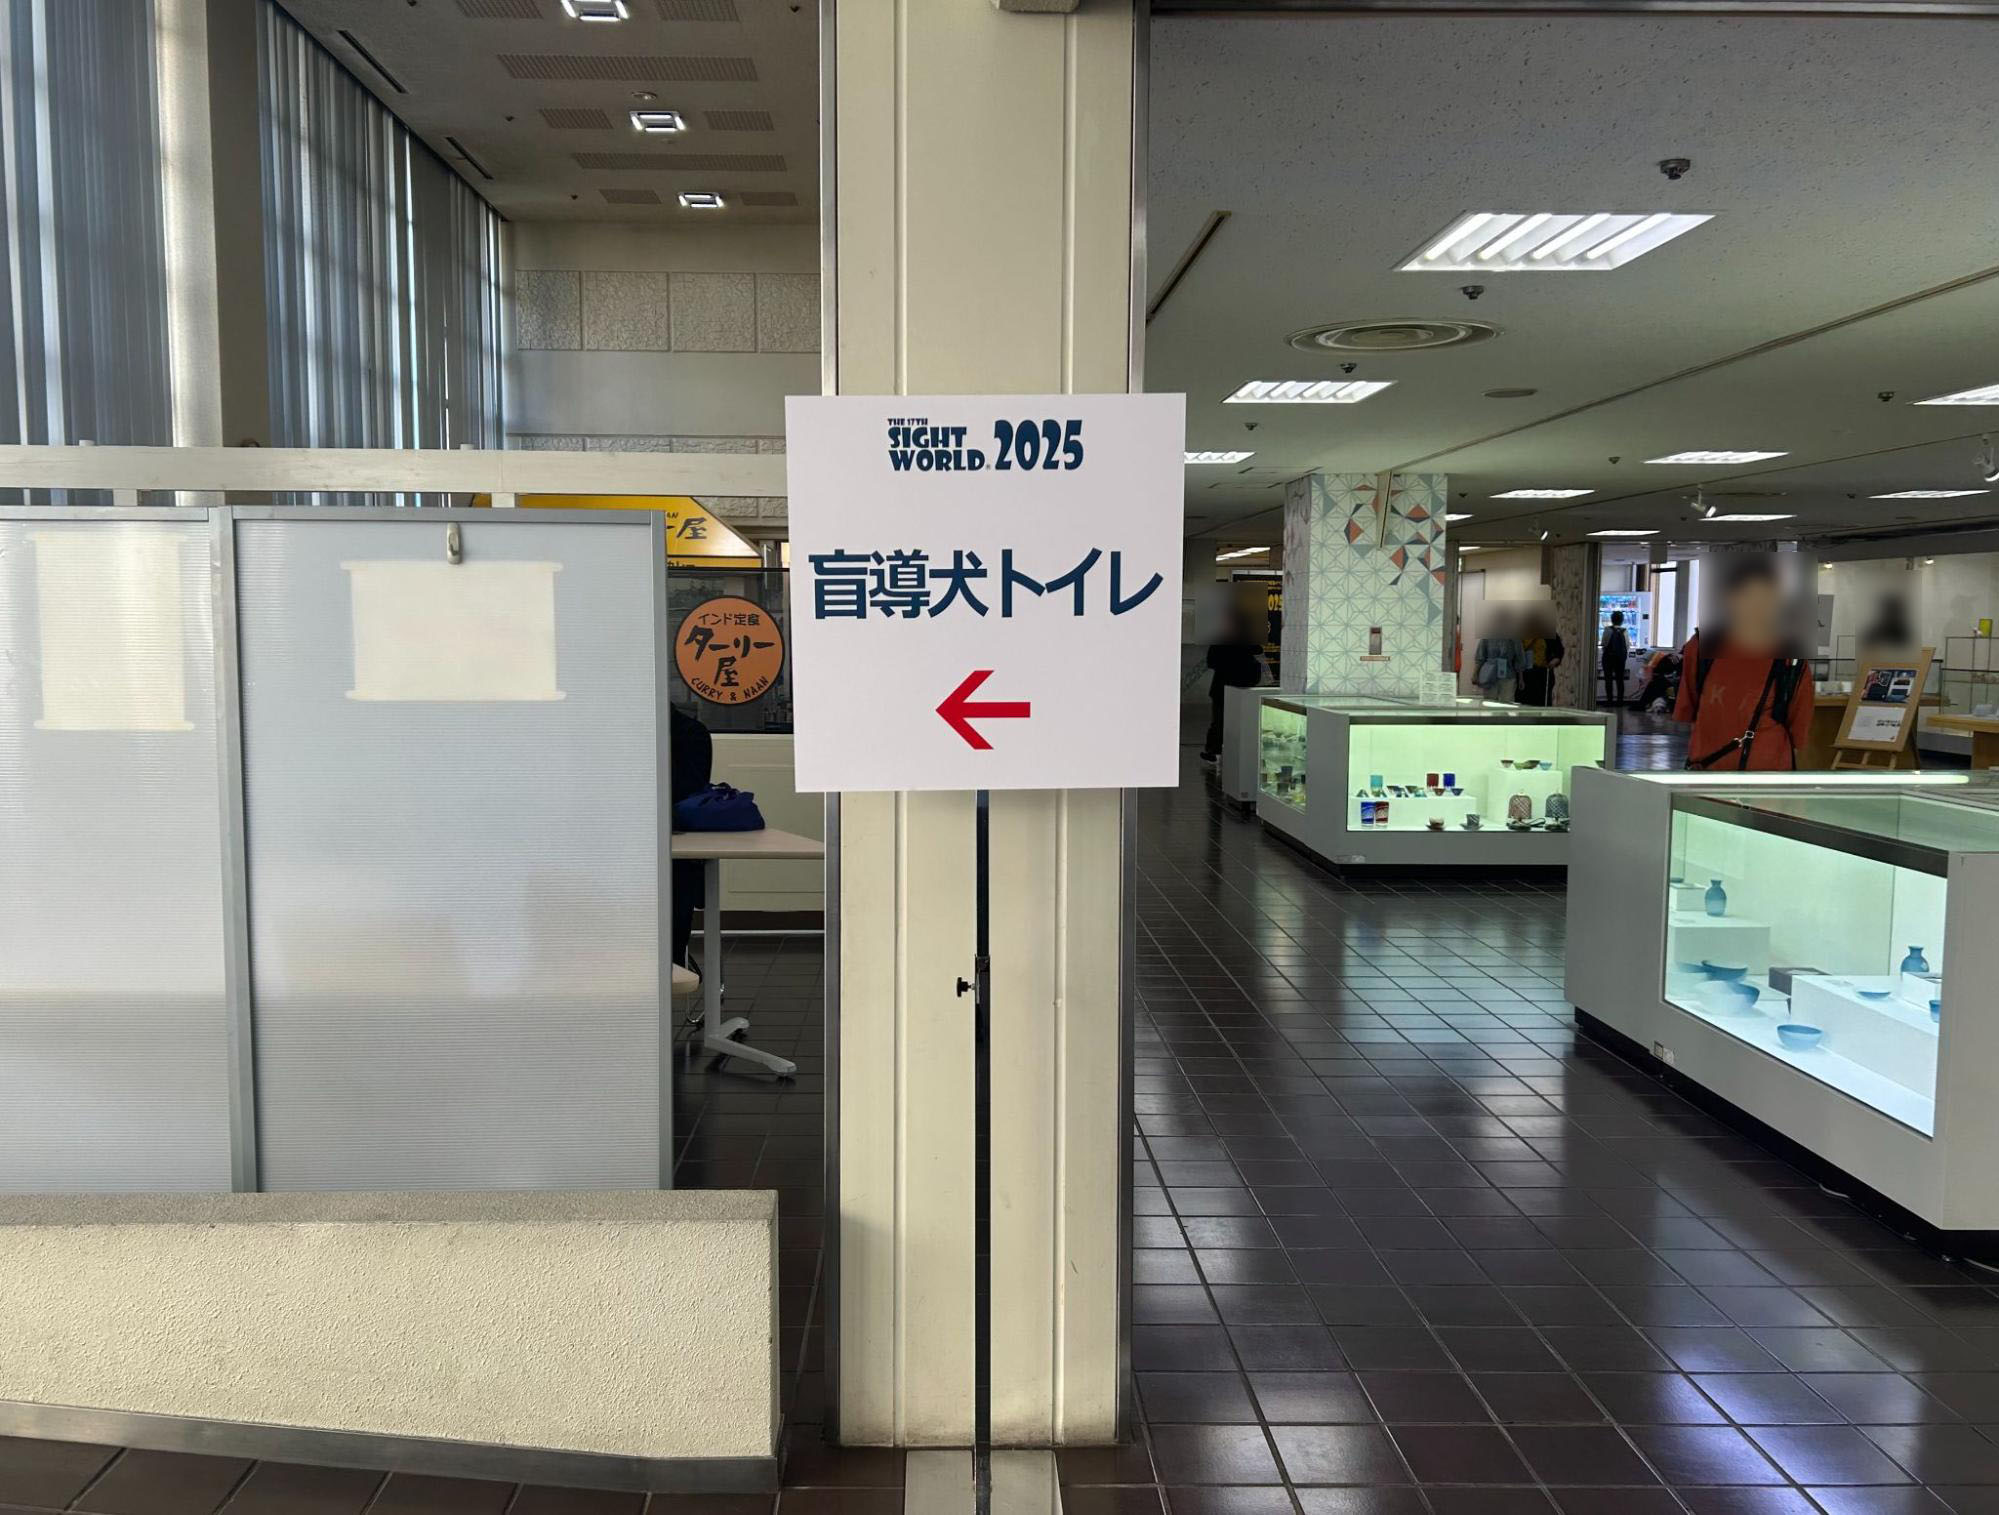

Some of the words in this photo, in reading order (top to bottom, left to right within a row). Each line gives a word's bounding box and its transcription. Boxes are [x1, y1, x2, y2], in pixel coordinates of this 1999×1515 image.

[888, 418, 905, 426] THE
[907, 418, 928, 426] 17TH
[888, 426, 967, 448] SIGHT
[994, 419, 1084, 471] 2025
[808, 547, 1164, 620] 盲導犬トイレ
[698, 613, 760, 626] インド定食
[691, 677, 722, 700] CURRY
[730, 692, 737, 701] &
[743, 675, 769, 699] NAAN
